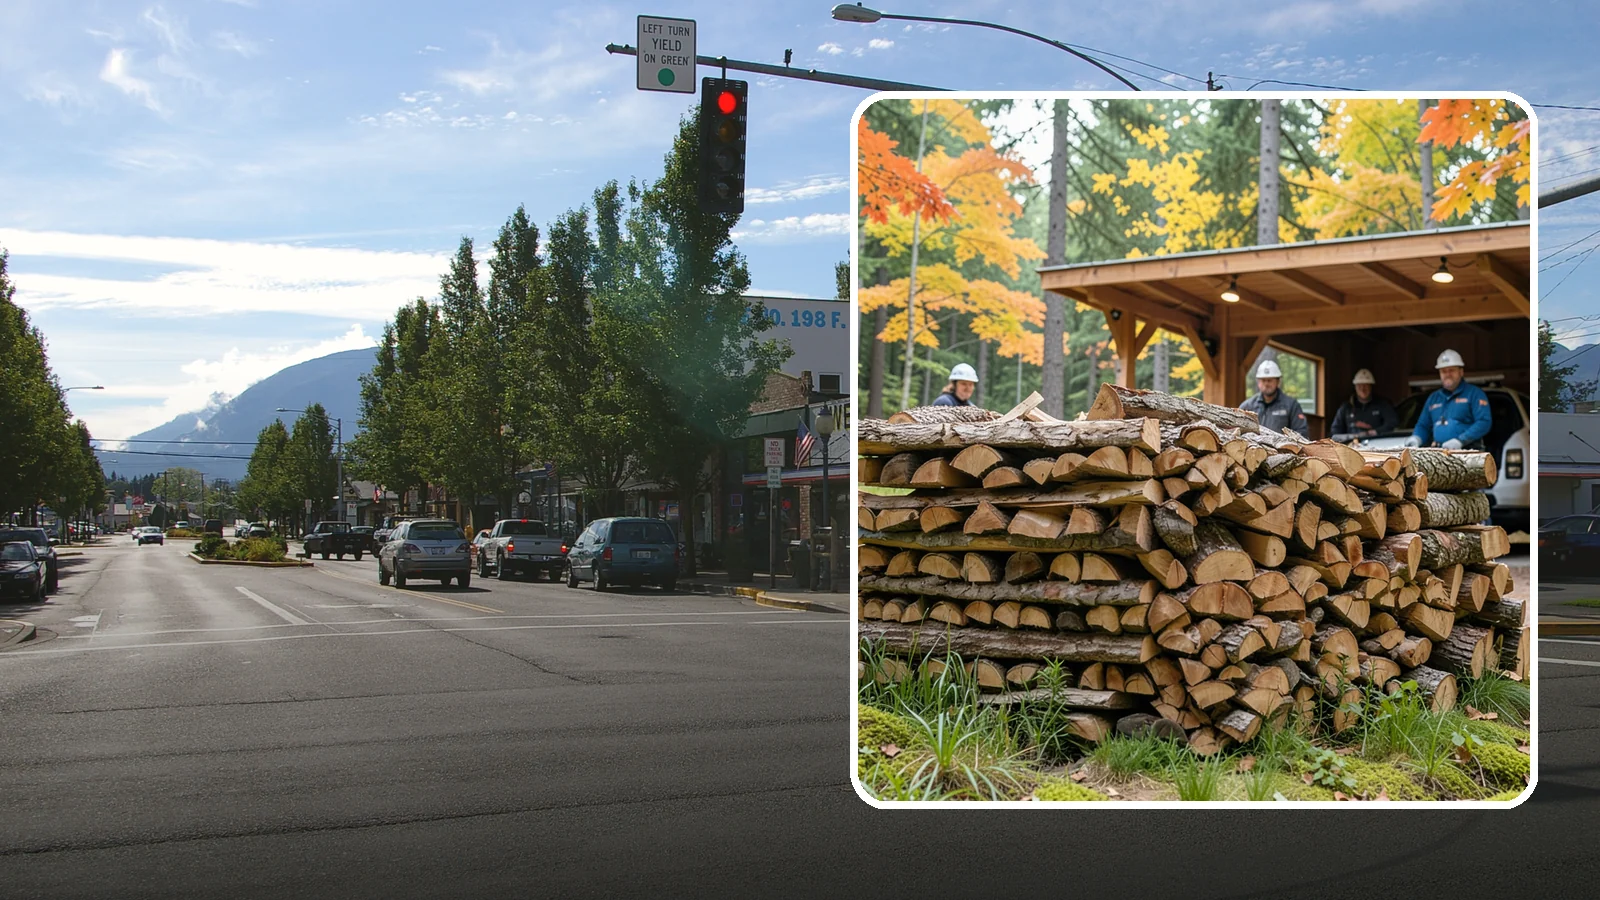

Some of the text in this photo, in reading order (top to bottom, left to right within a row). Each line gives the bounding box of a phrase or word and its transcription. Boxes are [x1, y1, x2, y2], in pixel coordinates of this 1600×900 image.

[643, 24, 690, 36] LEFT TURN
[652, 38, 682, 51] YIELD
[644, 53, 689, 66] ON GREEN
[791, 310, 826, 328] 198
[831, 311, 847, 329] F.
